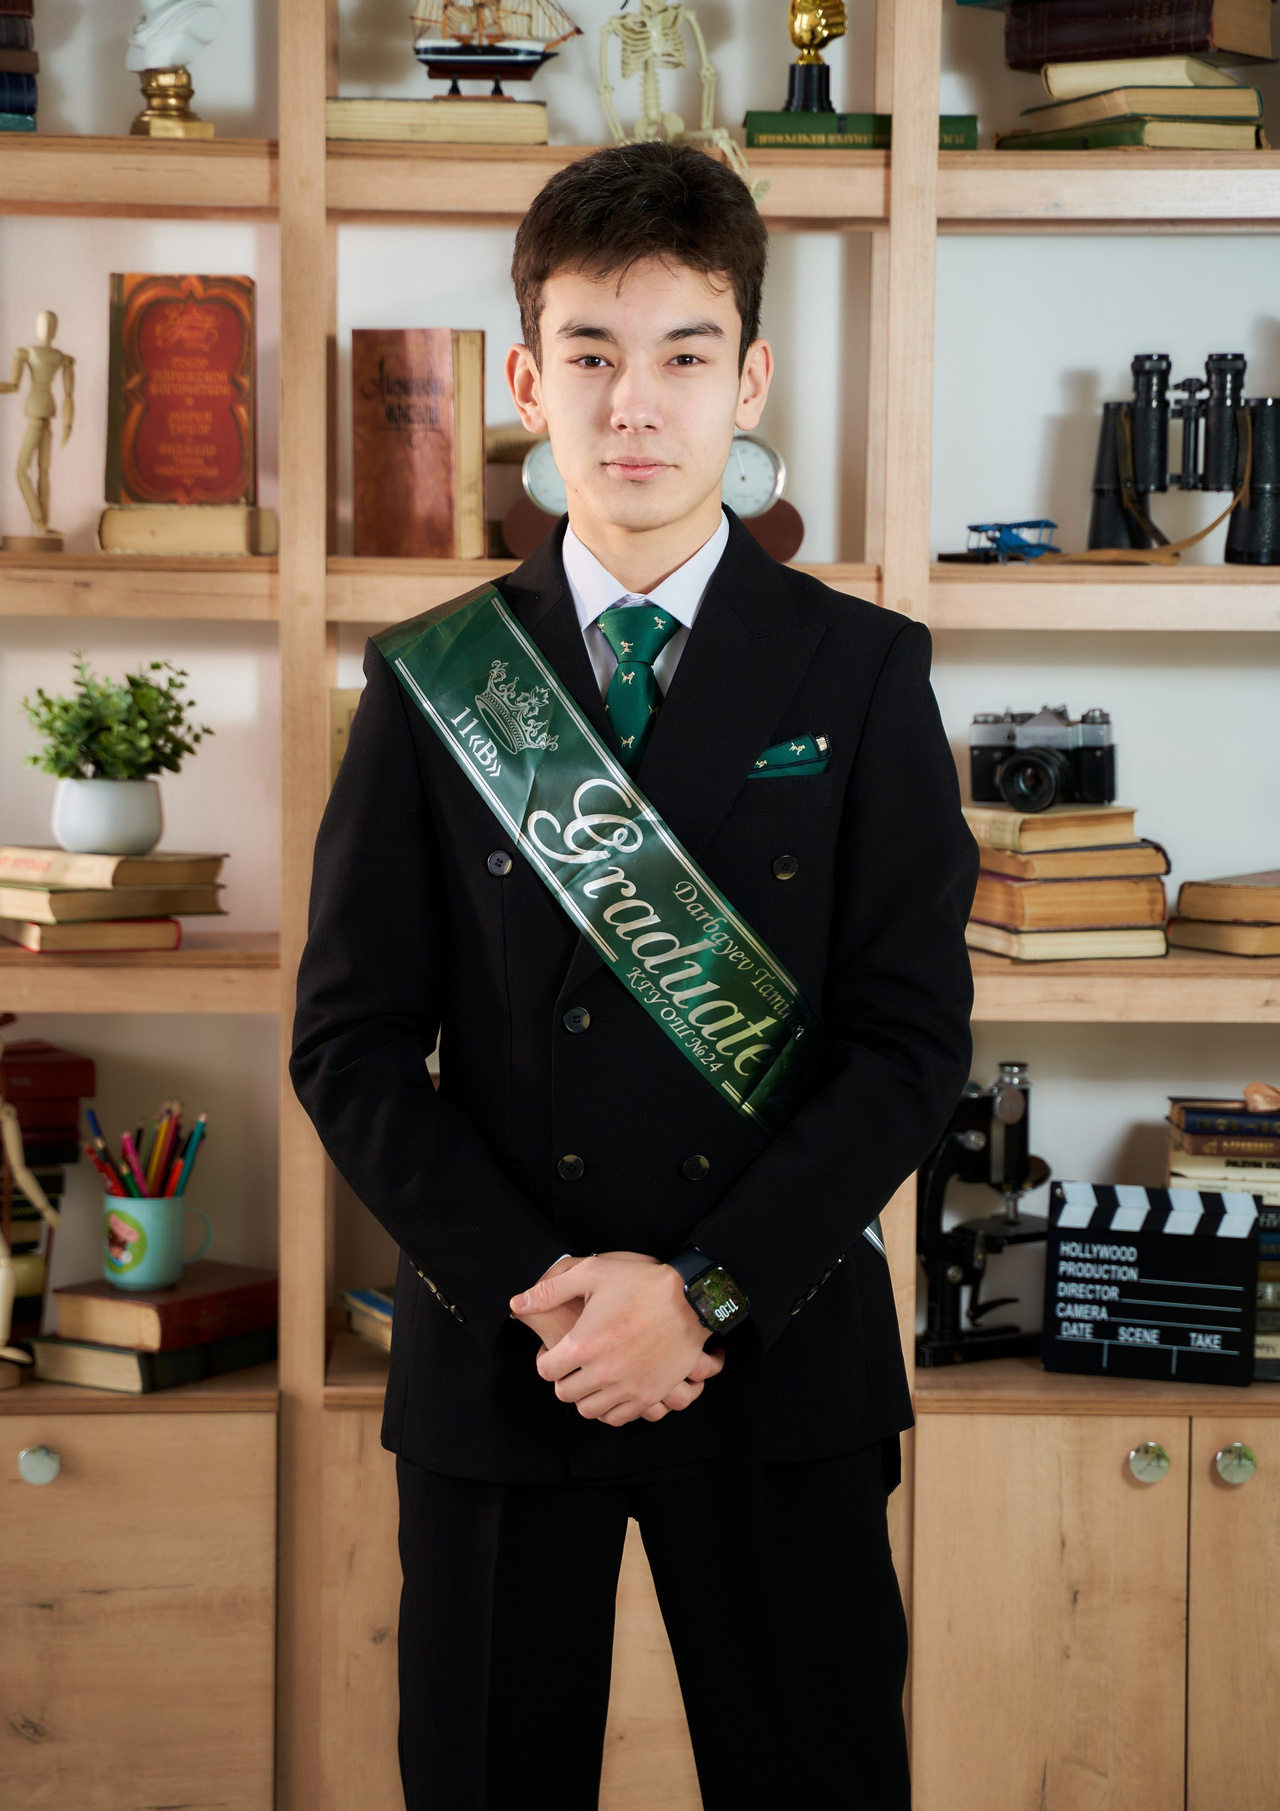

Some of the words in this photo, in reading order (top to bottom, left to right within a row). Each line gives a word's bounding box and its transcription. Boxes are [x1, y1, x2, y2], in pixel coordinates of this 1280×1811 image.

[526, 777, 778, 1077] Graduate
[672, 880, 754, 970] Darbayev
[626, 966, 669, 1004] КГУ
[660, 1007, 696, 1040] ОШ
[1059, 1240, 1138, 1262] HOLLYWOOD
[1058, 1260, 1139, 1282] PRODUCTION
[1056, 1281, 1120, 1301] DIRECTOR
[714, 1298, 739, 1322] 11:06
[1055, 1301, 1109, 1321] CAMERA
[1060, 1321, 1095, 1339] DATE
[1117, 1325, 1161, 1345] SCENE
[1188, 1331, 1223, 1350] TAKE
